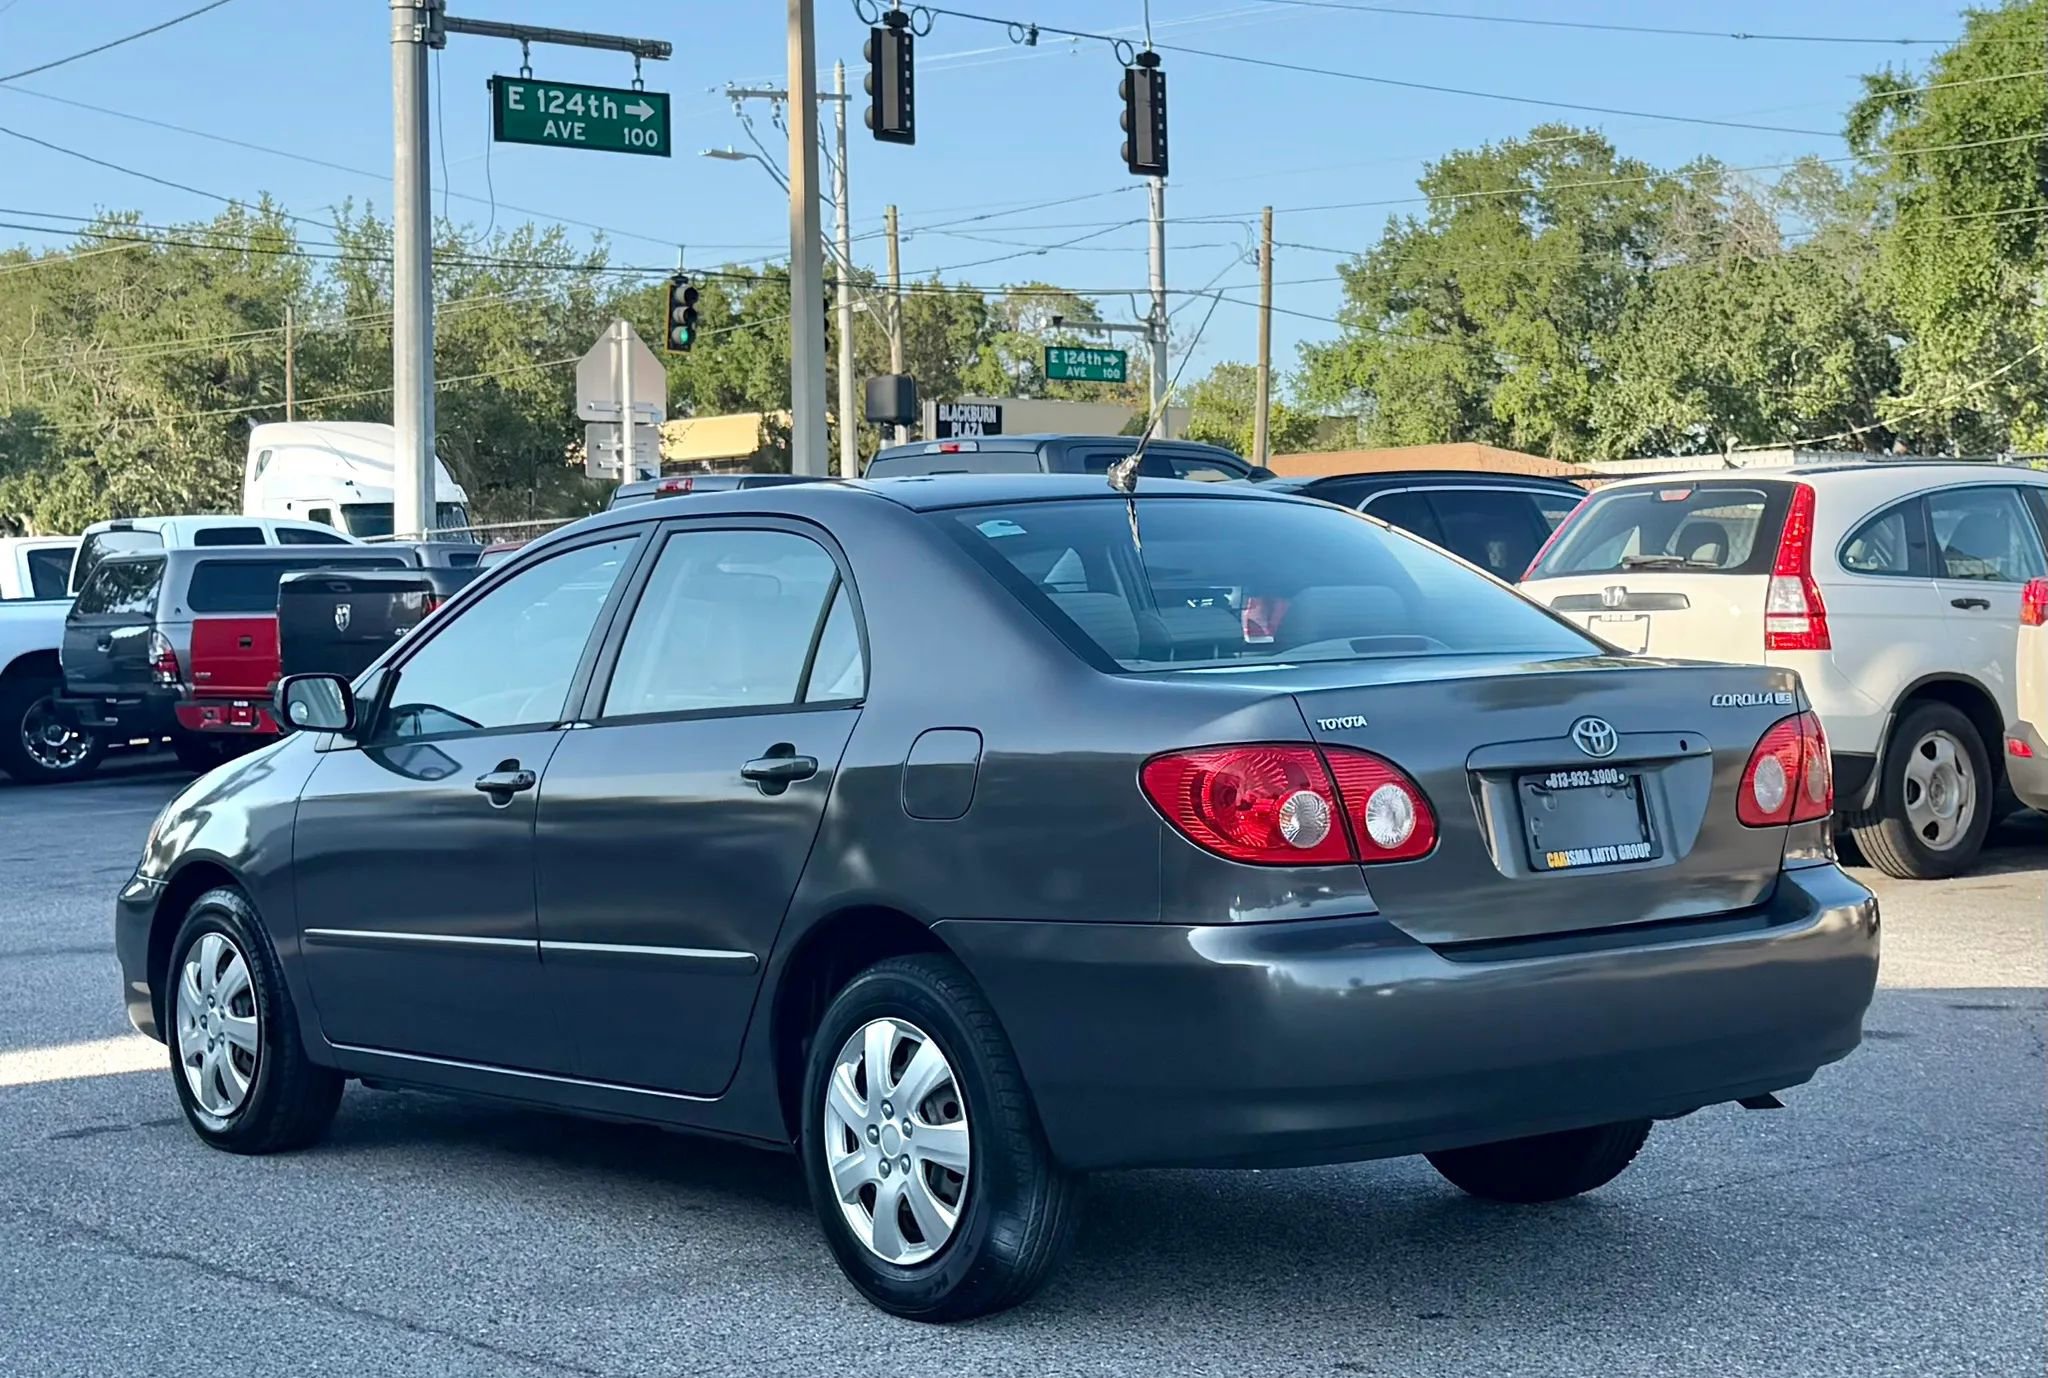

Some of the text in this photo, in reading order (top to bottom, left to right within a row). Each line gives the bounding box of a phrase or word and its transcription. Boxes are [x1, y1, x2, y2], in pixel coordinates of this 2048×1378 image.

[508, 86, 617, 119] E 124th
[543, 119, 659, 147] AVE 100
[1050, 350, 1102, 366] E 124th
[1066, 366, 1121, 379] AVE 100
[939, 404, 997, 423] BLACKBURN
[951, 421, 985, 438] PLAZA
[1711, 692, 1793, 707] COROLLA LE
[1317, 715, 1368, 731] TOYOTA
[1550, 769, 1618, 788] 813-932-3900
[1546, 842, 1651, 868] CARISMA AUTO GROUP
